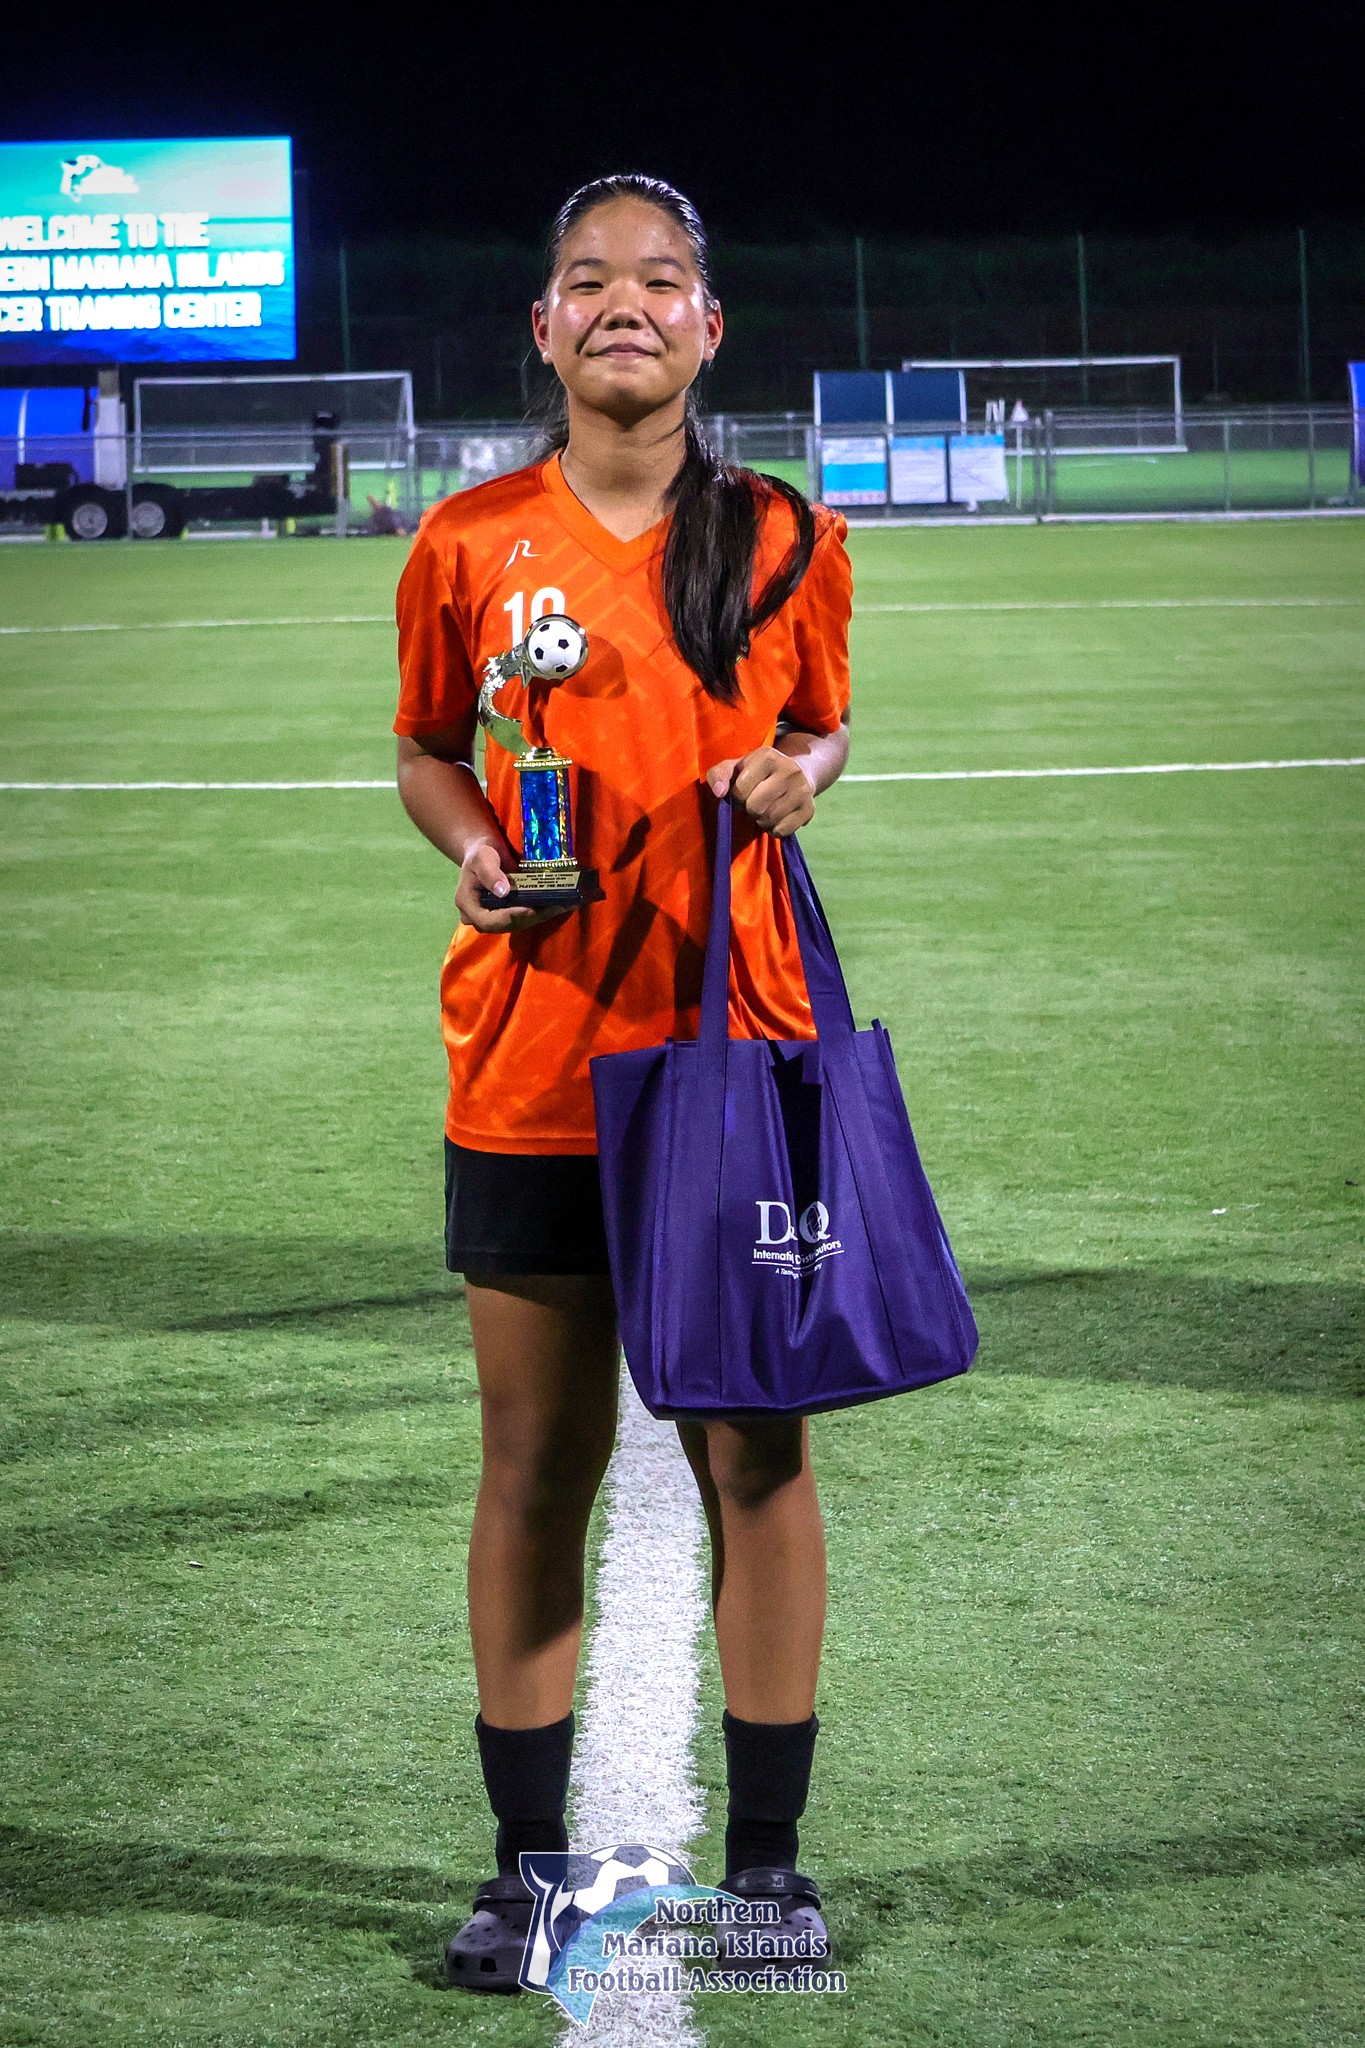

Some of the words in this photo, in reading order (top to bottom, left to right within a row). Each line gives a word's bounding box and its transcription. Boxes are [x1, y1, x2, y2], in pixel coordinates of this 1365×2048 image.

[0, 214, 121, 250] WELCOME
[123, 213, 158, 248] TO
[160, 212, 210, 247] THE
[53, 254, 174, 290] MARIANA
[176, 251, 285, 287] ISLANDS
[45, 295, 161, 331] TRAINING
[164, 292, 262, 328] CENTER
